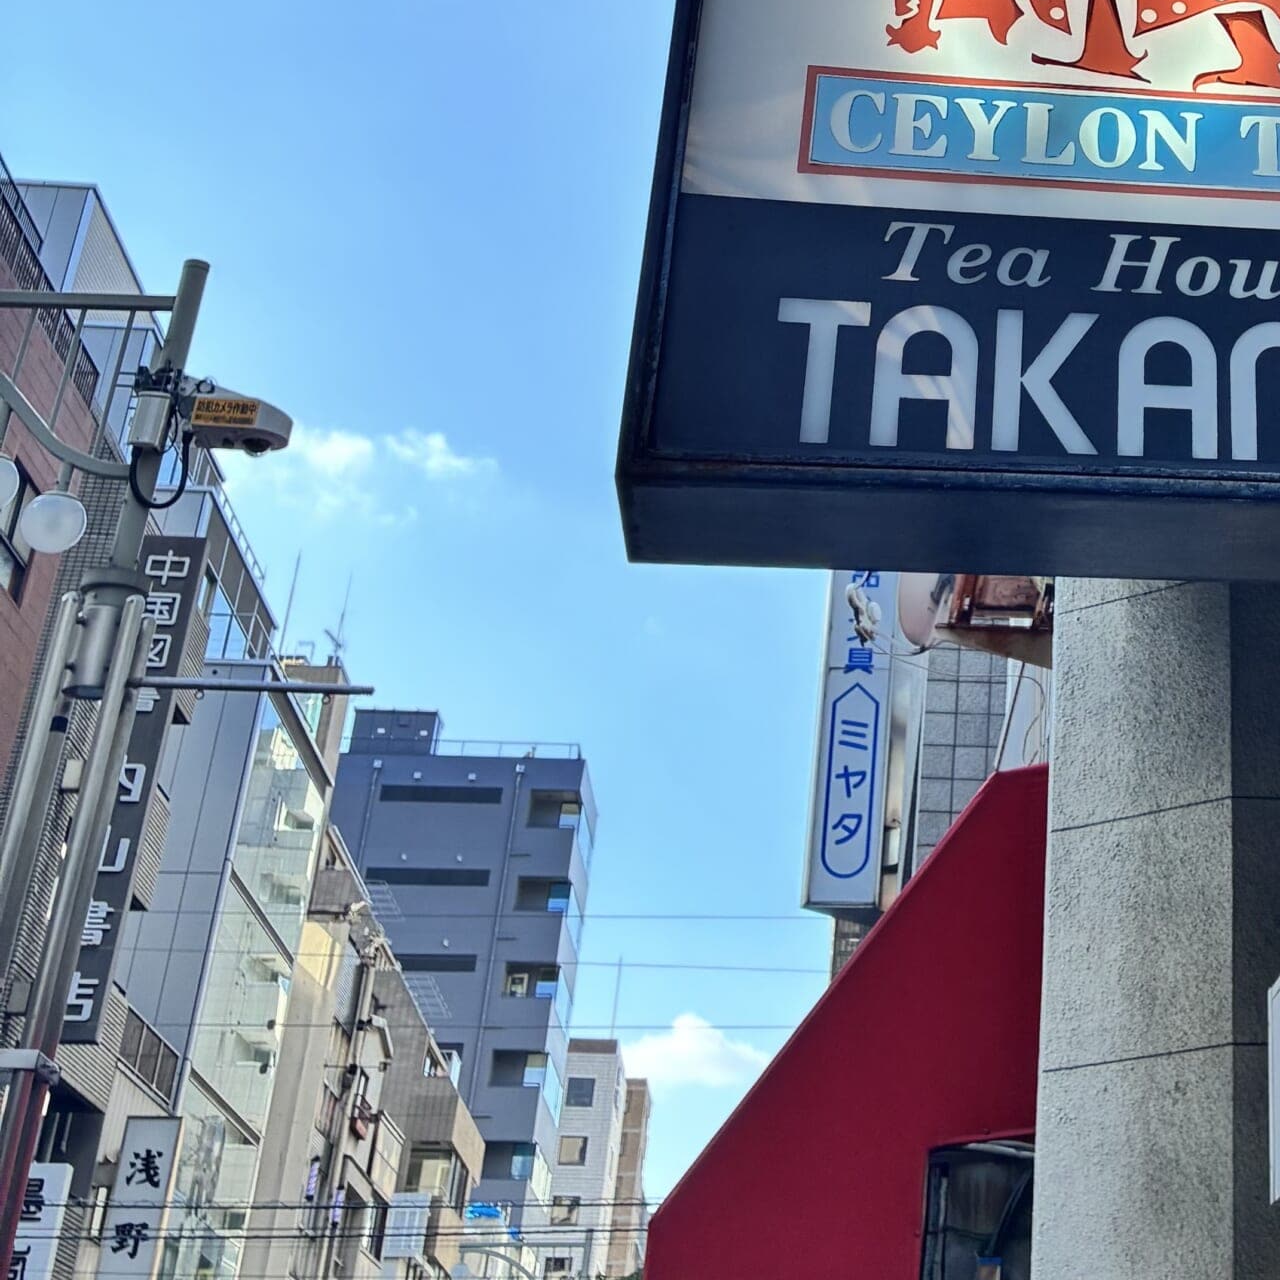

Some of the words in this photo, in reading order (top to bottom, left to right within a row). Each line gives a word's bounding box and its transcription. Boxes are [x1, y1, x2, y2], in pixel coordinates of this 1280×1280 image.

[828, 89, 1204, 173] CEYLON
[881, 220, 1052, 289] Tea
[832, 719, 869, 845] ミヤタ
[111, 1149, 163, 1259] 浅野
